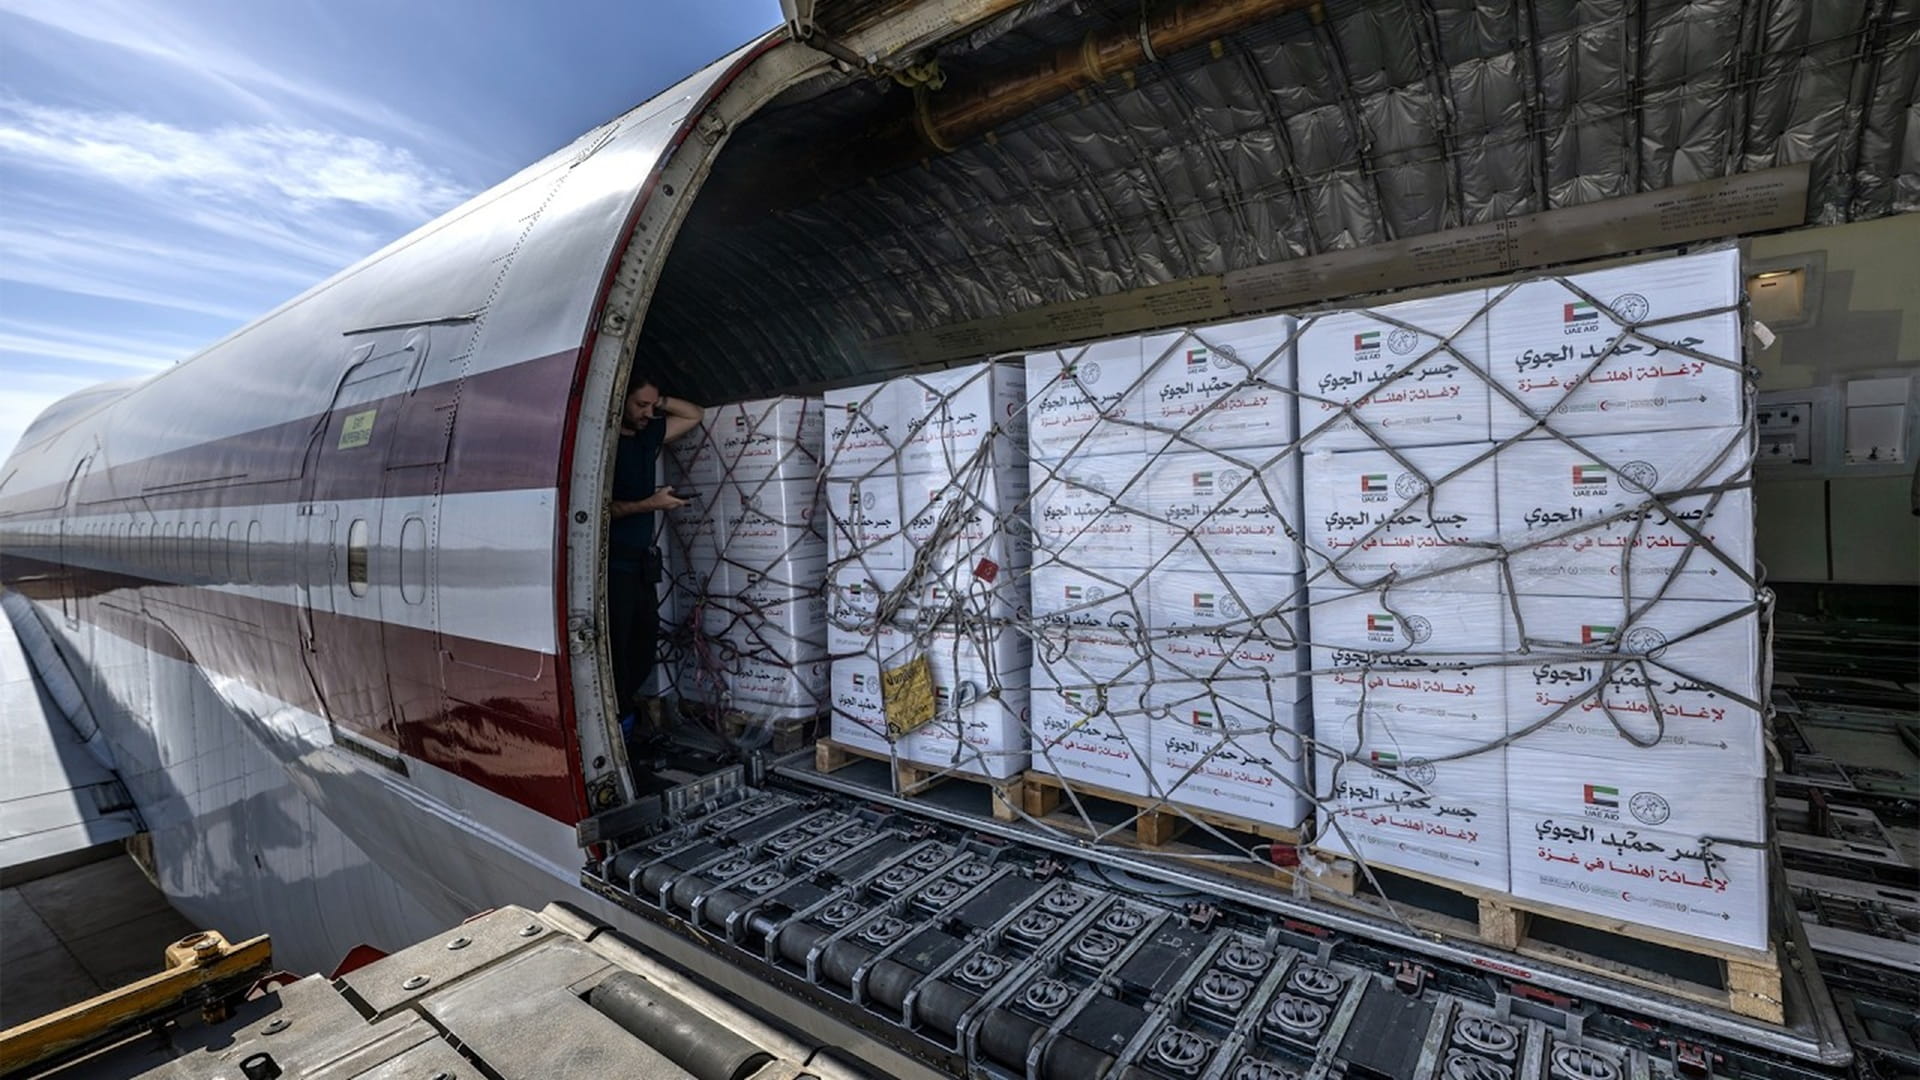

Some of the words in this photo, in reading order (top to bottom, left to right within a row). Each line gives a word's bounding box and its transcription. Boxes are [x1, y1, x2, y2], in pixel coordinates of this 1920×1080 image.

[1563, 326, 1583, 336] UAE
[1583, 325, 1599, 334] AID
[1515, 344, 1573, 373] الجوي
[1416, 362, 1460, 382] جسر
[1637, 361, 1705, 382] لإغاثة
[1159, 382, 1194, 402] الجوي
[1318, 370, 1363, 395] الجوي
[1517, 376, 1560, 393] غزة
[1573, 489, 1591, 497] UAE
[1164, 503, 1200, 521] الجوي
[1325, 511, 1369, 532] الجوي
[1425, 513, 1468, 529] جسر
[1524, 507, 1583, 531] الجوي
[1361, 537, 1377, 551] في
[1381, 535, 1415, 548] أهلنا
[1572, 536, 1594, 553] في
[1532, 663, 1592, 686] الجوي
[1387, 677, 1421, 692] أهلنا
[1422, 679, 1476, 697] لإغاثة
[1164, 736, 1200, 755] الجوي
[1370, 812, 1387, 827] في
[1434, 804, 1478, 823] جسر
[1584, 808, 1602, 820] UAE
[1604, 811, 1620, 822] AID
[1389, 815, 1425, 832] أهلنا
[1426, 822, 1479, 844] لإغاثة
[1535, 818, 1595, 844] الجوي
[1538, 846, 1580, 865] غزة
[1584, 856, 1605, 873] في
[1609, 860, 1655, 879] أهلنا
[1659, 867, 1729, 894] لإغاثة
